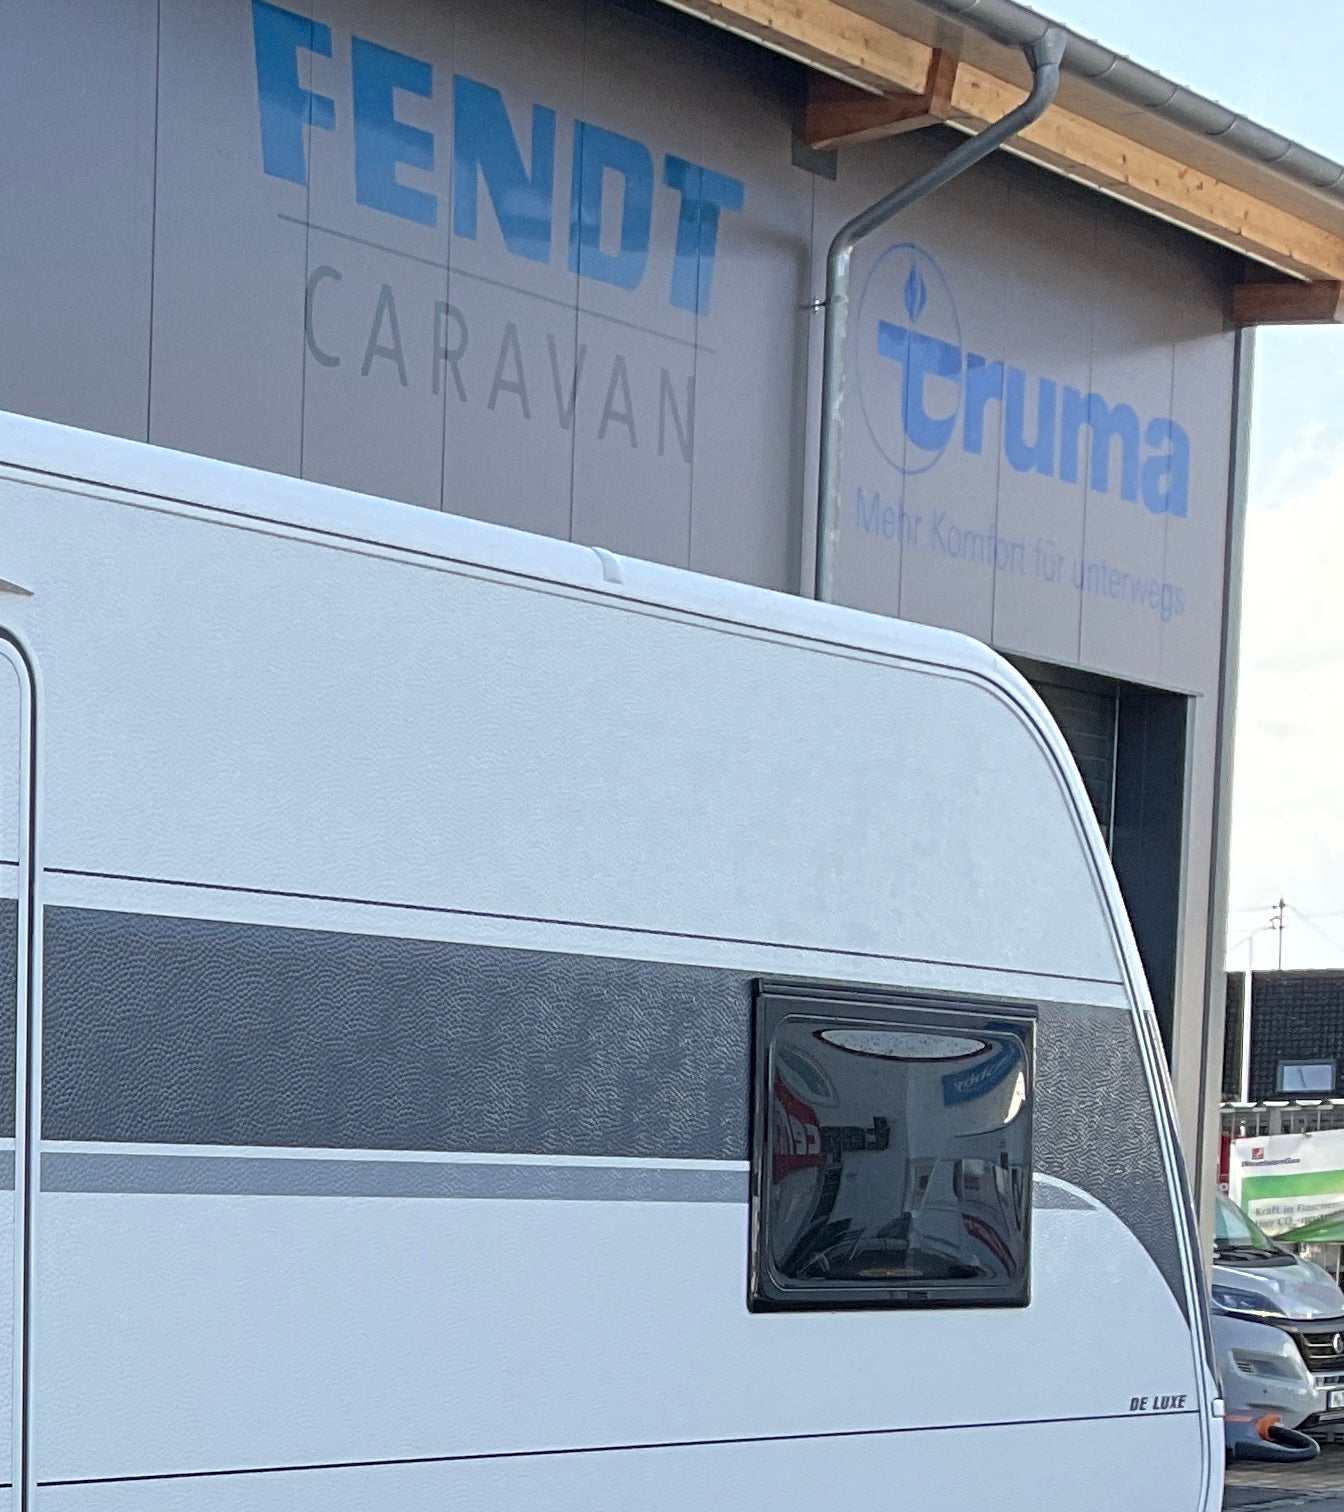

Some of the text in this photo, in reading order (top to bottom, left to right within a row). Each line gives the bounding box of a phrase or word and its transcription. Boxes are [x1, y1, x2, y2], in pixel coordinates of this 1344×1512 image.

[250, 0, 746, 317] FENDT
[304, 264, 696, 464] CARAVAN
[876, 319, 1192, 519] truma
[854, 486, 1186, 623] Mehr Komfort für unterwegs
[1129, 1394, 1187, 1412] DE LUXE
